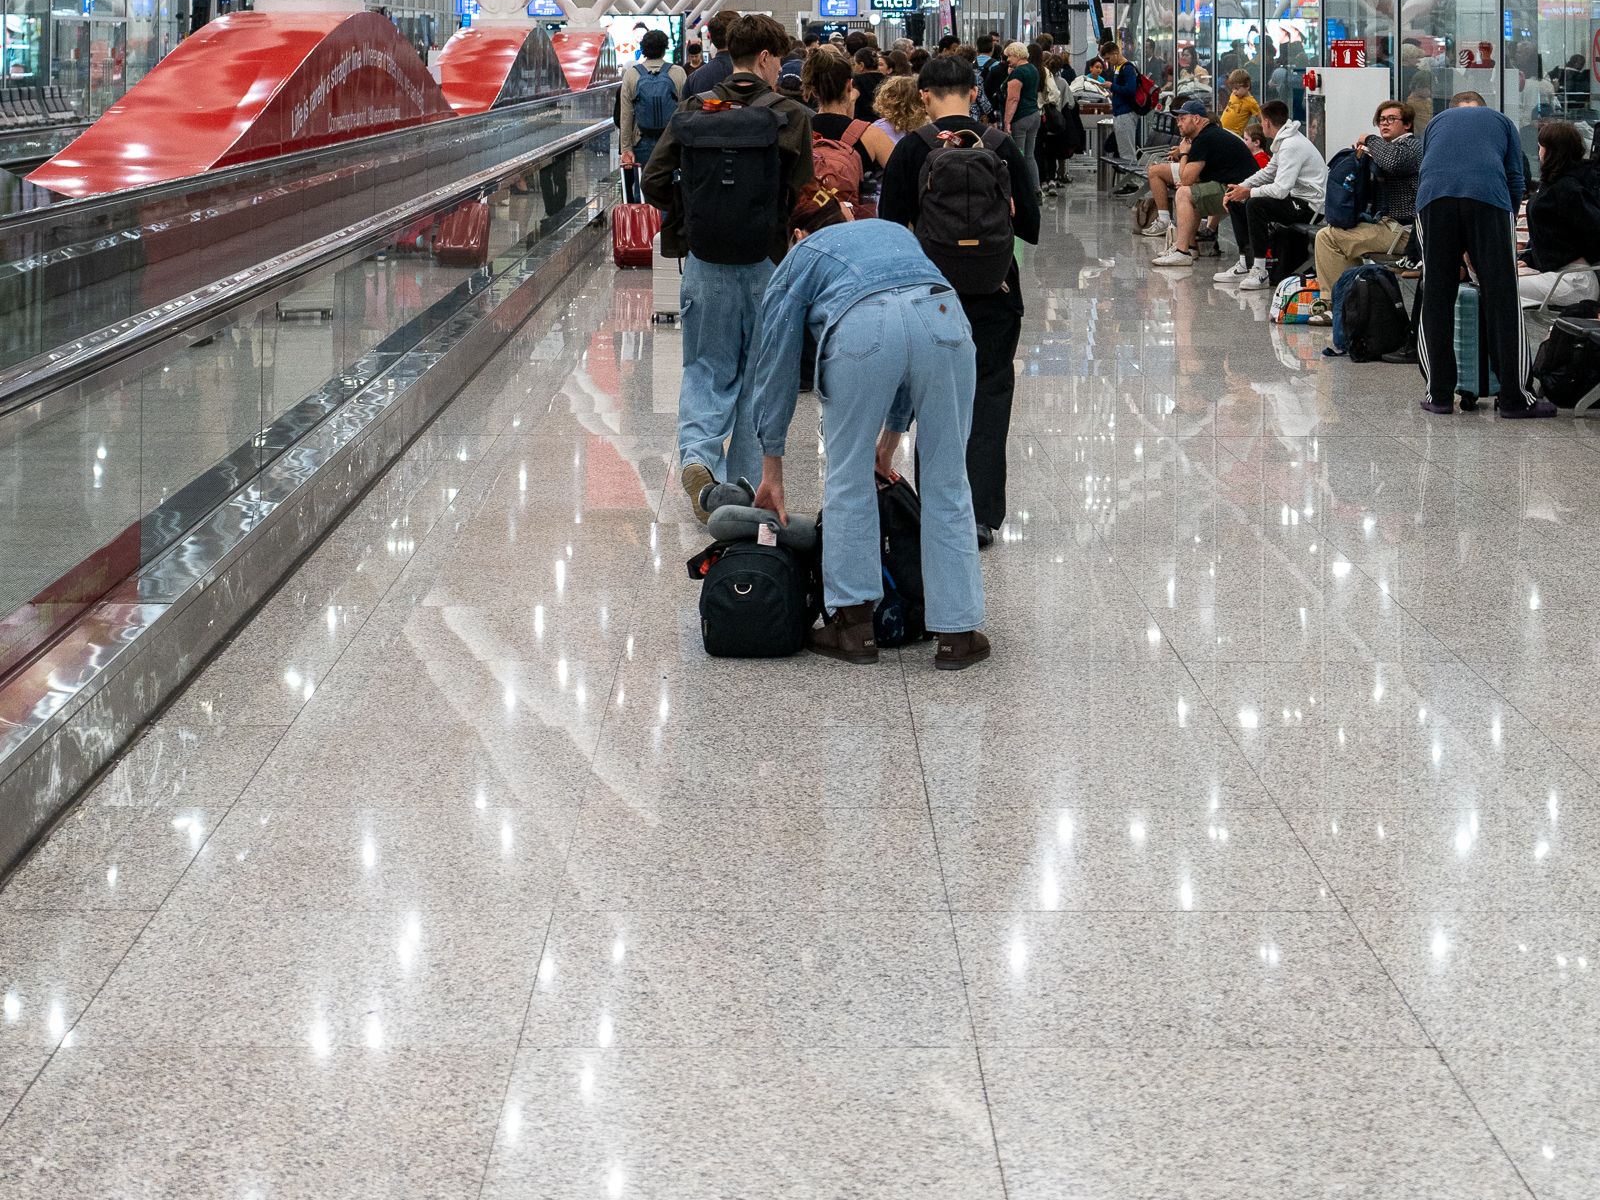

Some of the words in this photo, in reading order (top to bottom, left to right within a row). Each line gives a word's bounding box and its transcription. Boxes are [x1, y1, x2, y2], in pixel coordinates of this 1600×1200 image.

[291, 102, 303, 138] Life
[309, 75, 326, 114] rarely
[331, 51, 352, 88] straight
